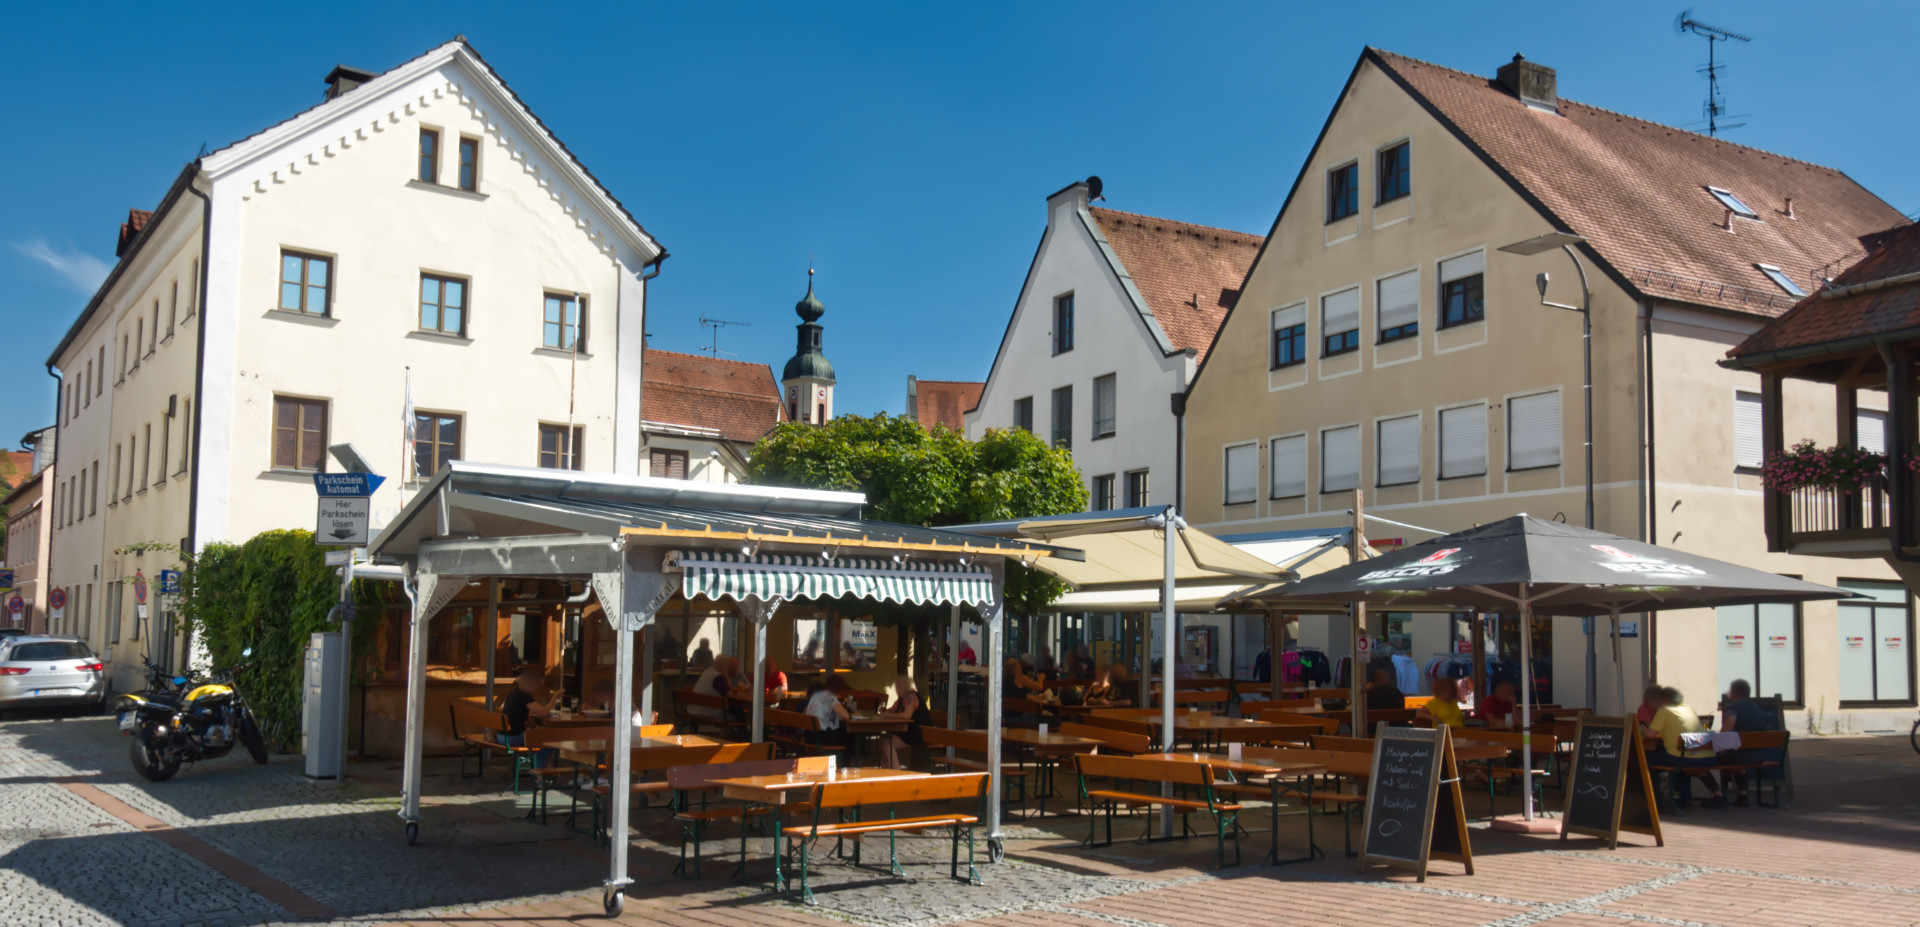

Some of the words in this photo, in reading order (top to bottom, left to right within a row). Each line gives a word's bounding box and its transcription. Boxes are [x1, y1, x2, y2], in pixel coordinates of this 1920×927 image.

[318, 475, 363, 485] Parkschein
[327, 485, 360, 494] Automat
[335, 500, 351, 508] Hier
[321, 509, 365, 518] Parkschein
[332, 519, 353, 528] lösen
[595, 580, 617, 623] Central
